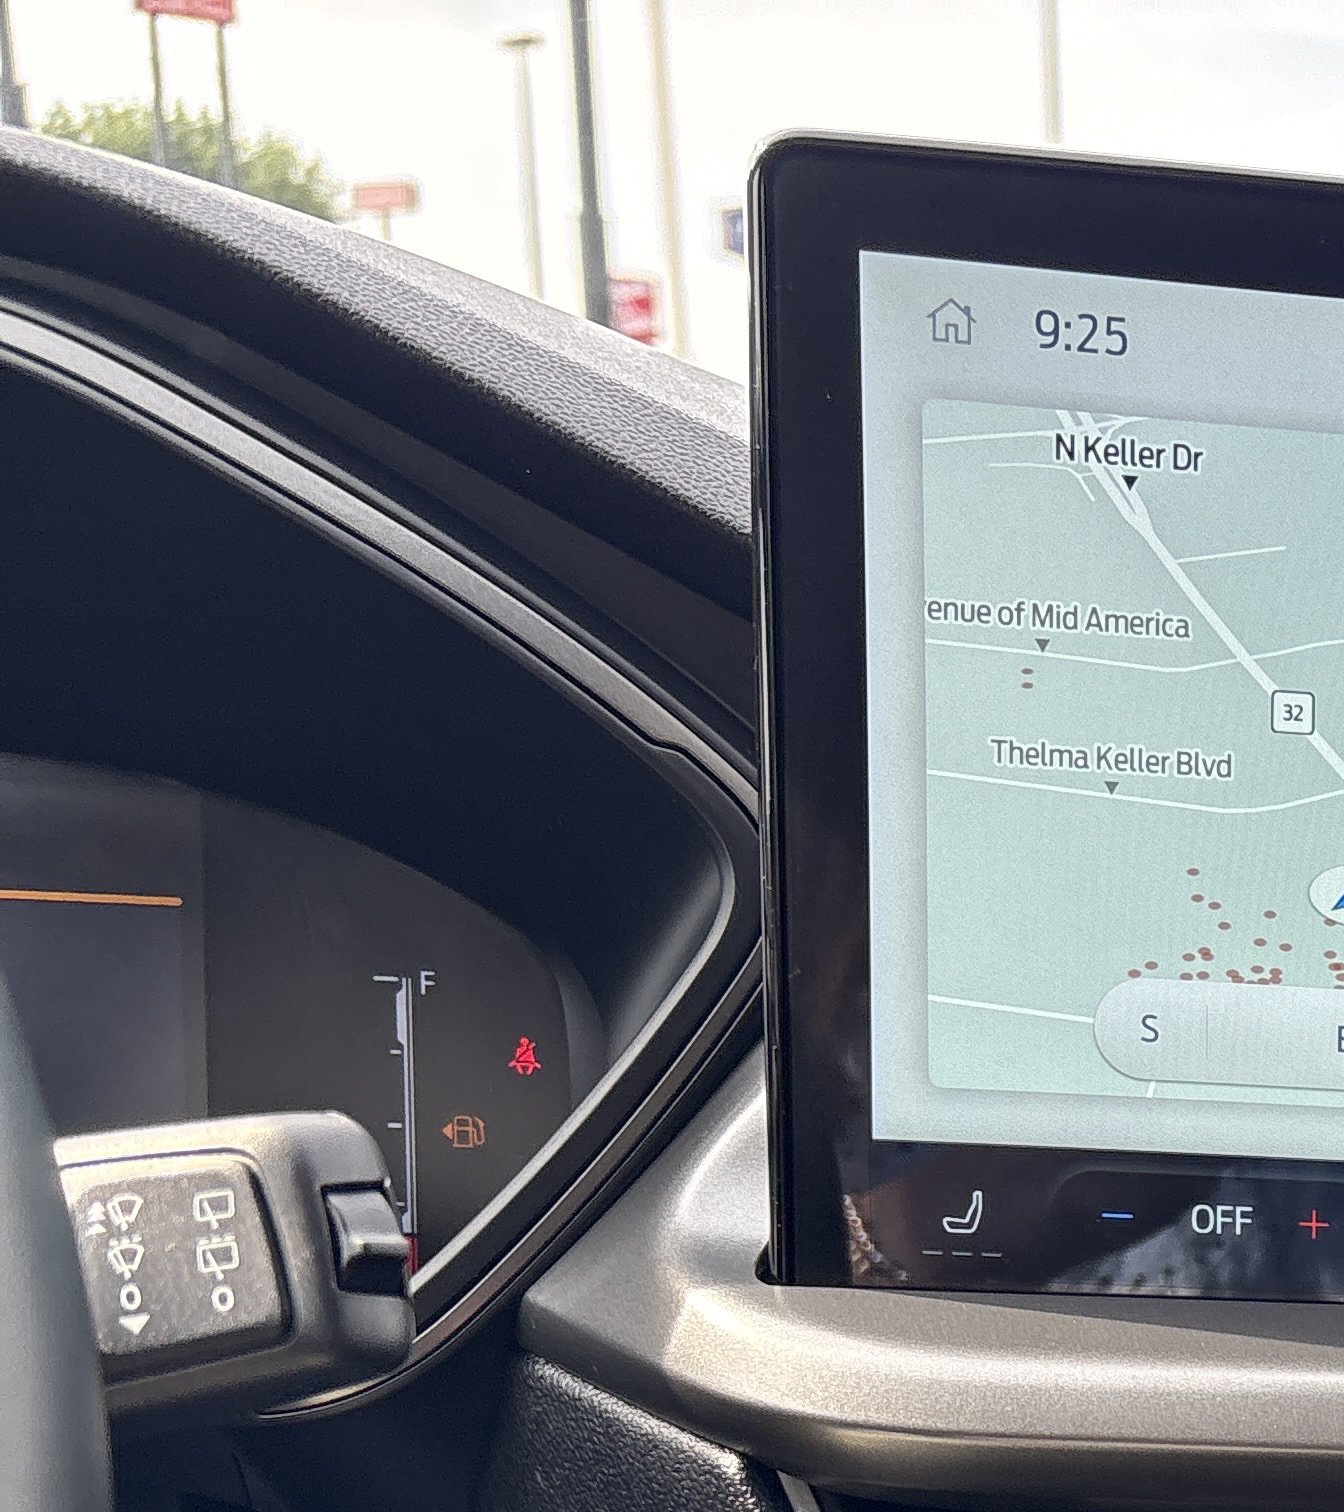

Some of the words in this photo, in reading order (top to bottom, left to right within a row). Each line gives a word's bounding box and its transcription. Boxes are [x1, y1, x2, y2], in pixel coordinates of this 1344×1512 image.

[1035, 309, 1128, 356] 9:25
[1055, 433, 1076, 462] N
[1084, 435, 1166, 468] Keller
[1173, 443, 1203, 472] Dr
[925, 600, 992, 624] enue
[999, 601, 1026, 626] of
[1032, 603, 1078, 630] Mid
[1085, 607, 1190, 638] America
[1283, 703, 1304, 722] 32
[991, 739, 1089, 769] Thelma
[1096, 746, 1170, 774] Keller
[1176, 751, 1232, 778] Blvd
[420, 970, 435, 995] F
[1140, 1014, 1159, 1043] S
[1191, 1204, 1253, 1236] OFF
